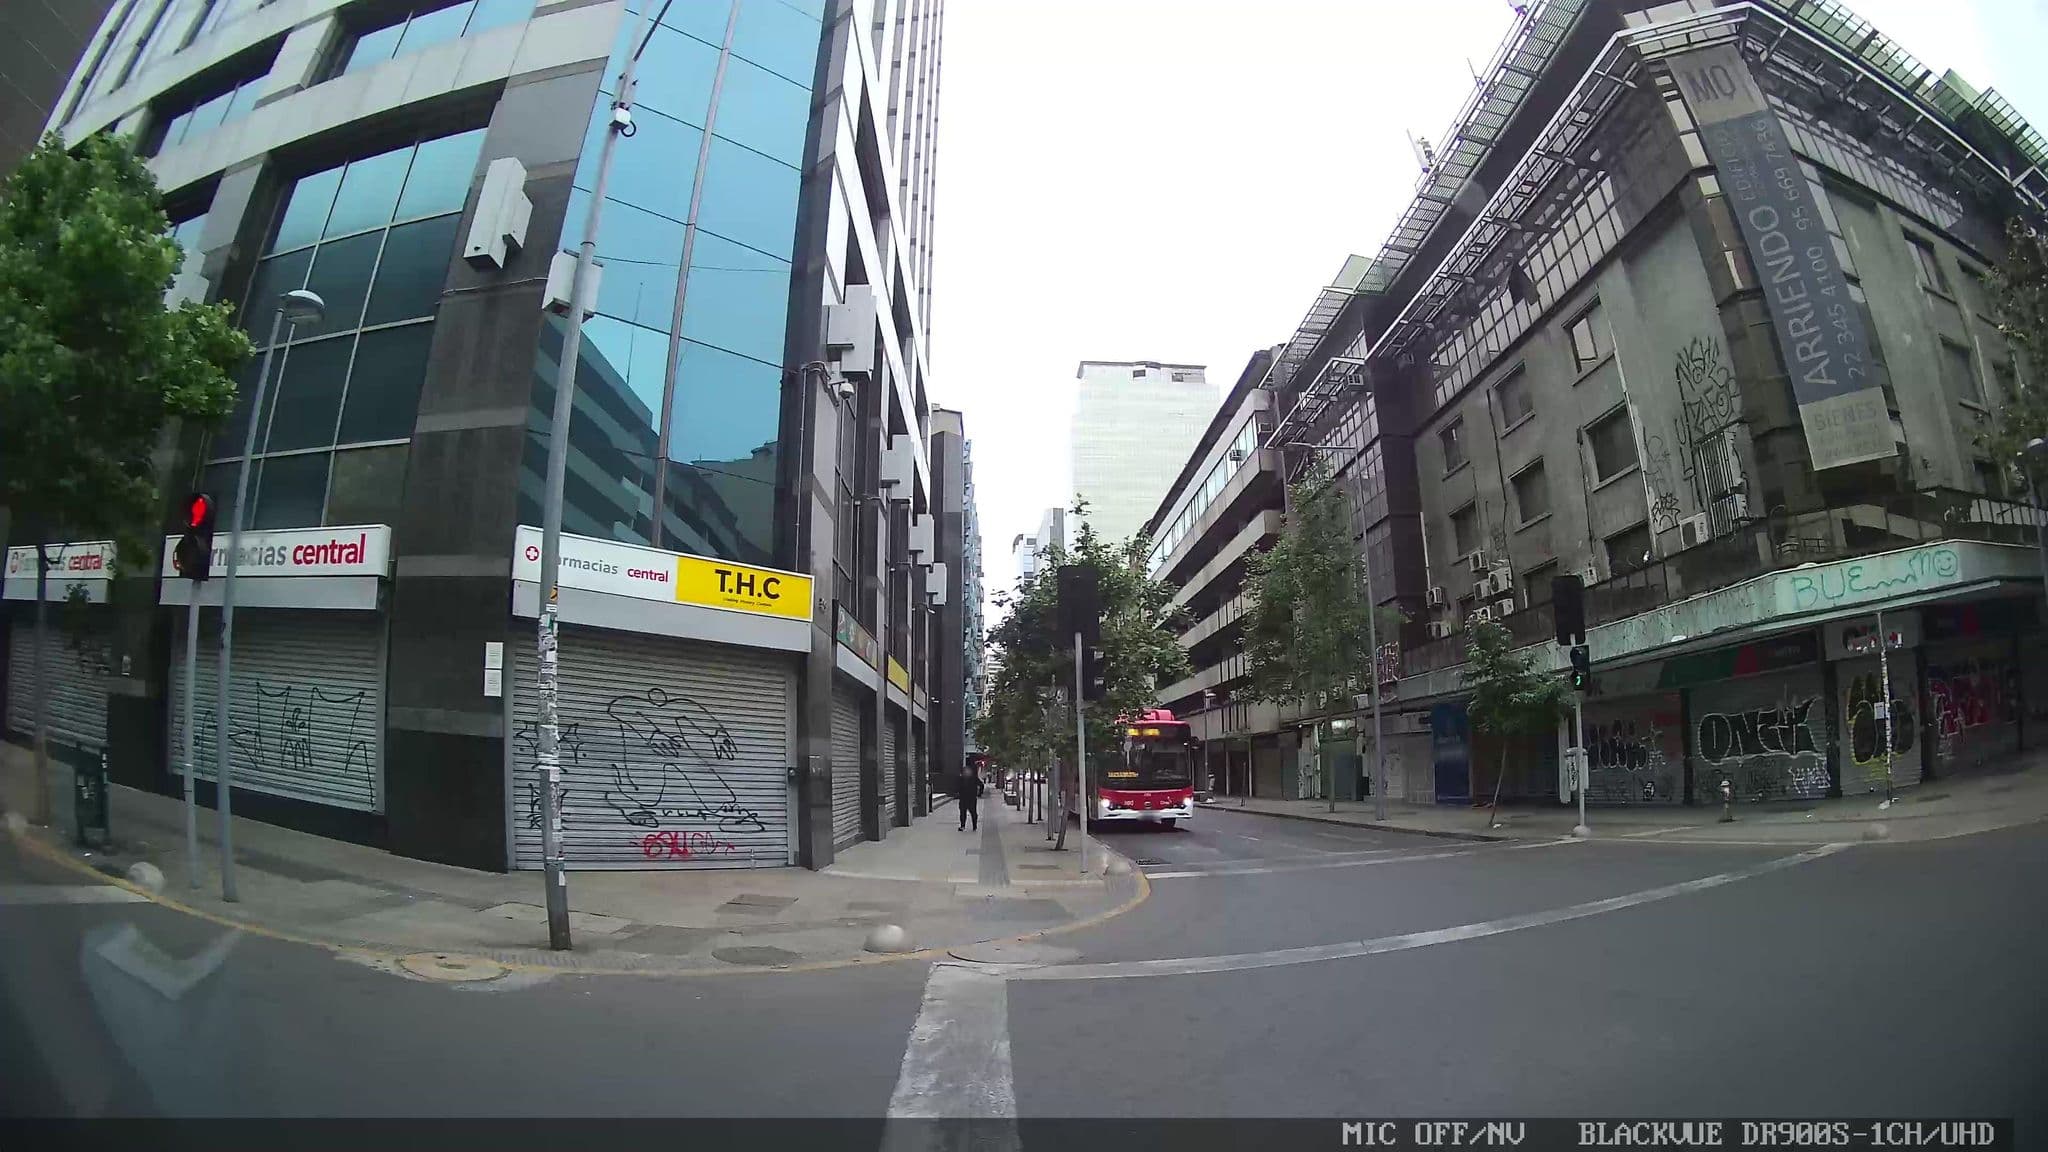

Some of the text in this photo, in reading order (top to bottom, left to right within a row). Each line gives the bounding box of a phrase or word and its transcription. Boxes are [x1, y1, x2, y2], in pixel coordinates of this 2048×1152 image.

[1807, 246, 1837, 297] 4100
[1749, 205, 1837, 385] ARRIENDO
[1827, 303, 1855, 345] 345
[292, 533, 367, 566] central
[627, 567, 669, 583] central
[714, 569, 782, 600] T.H.C
